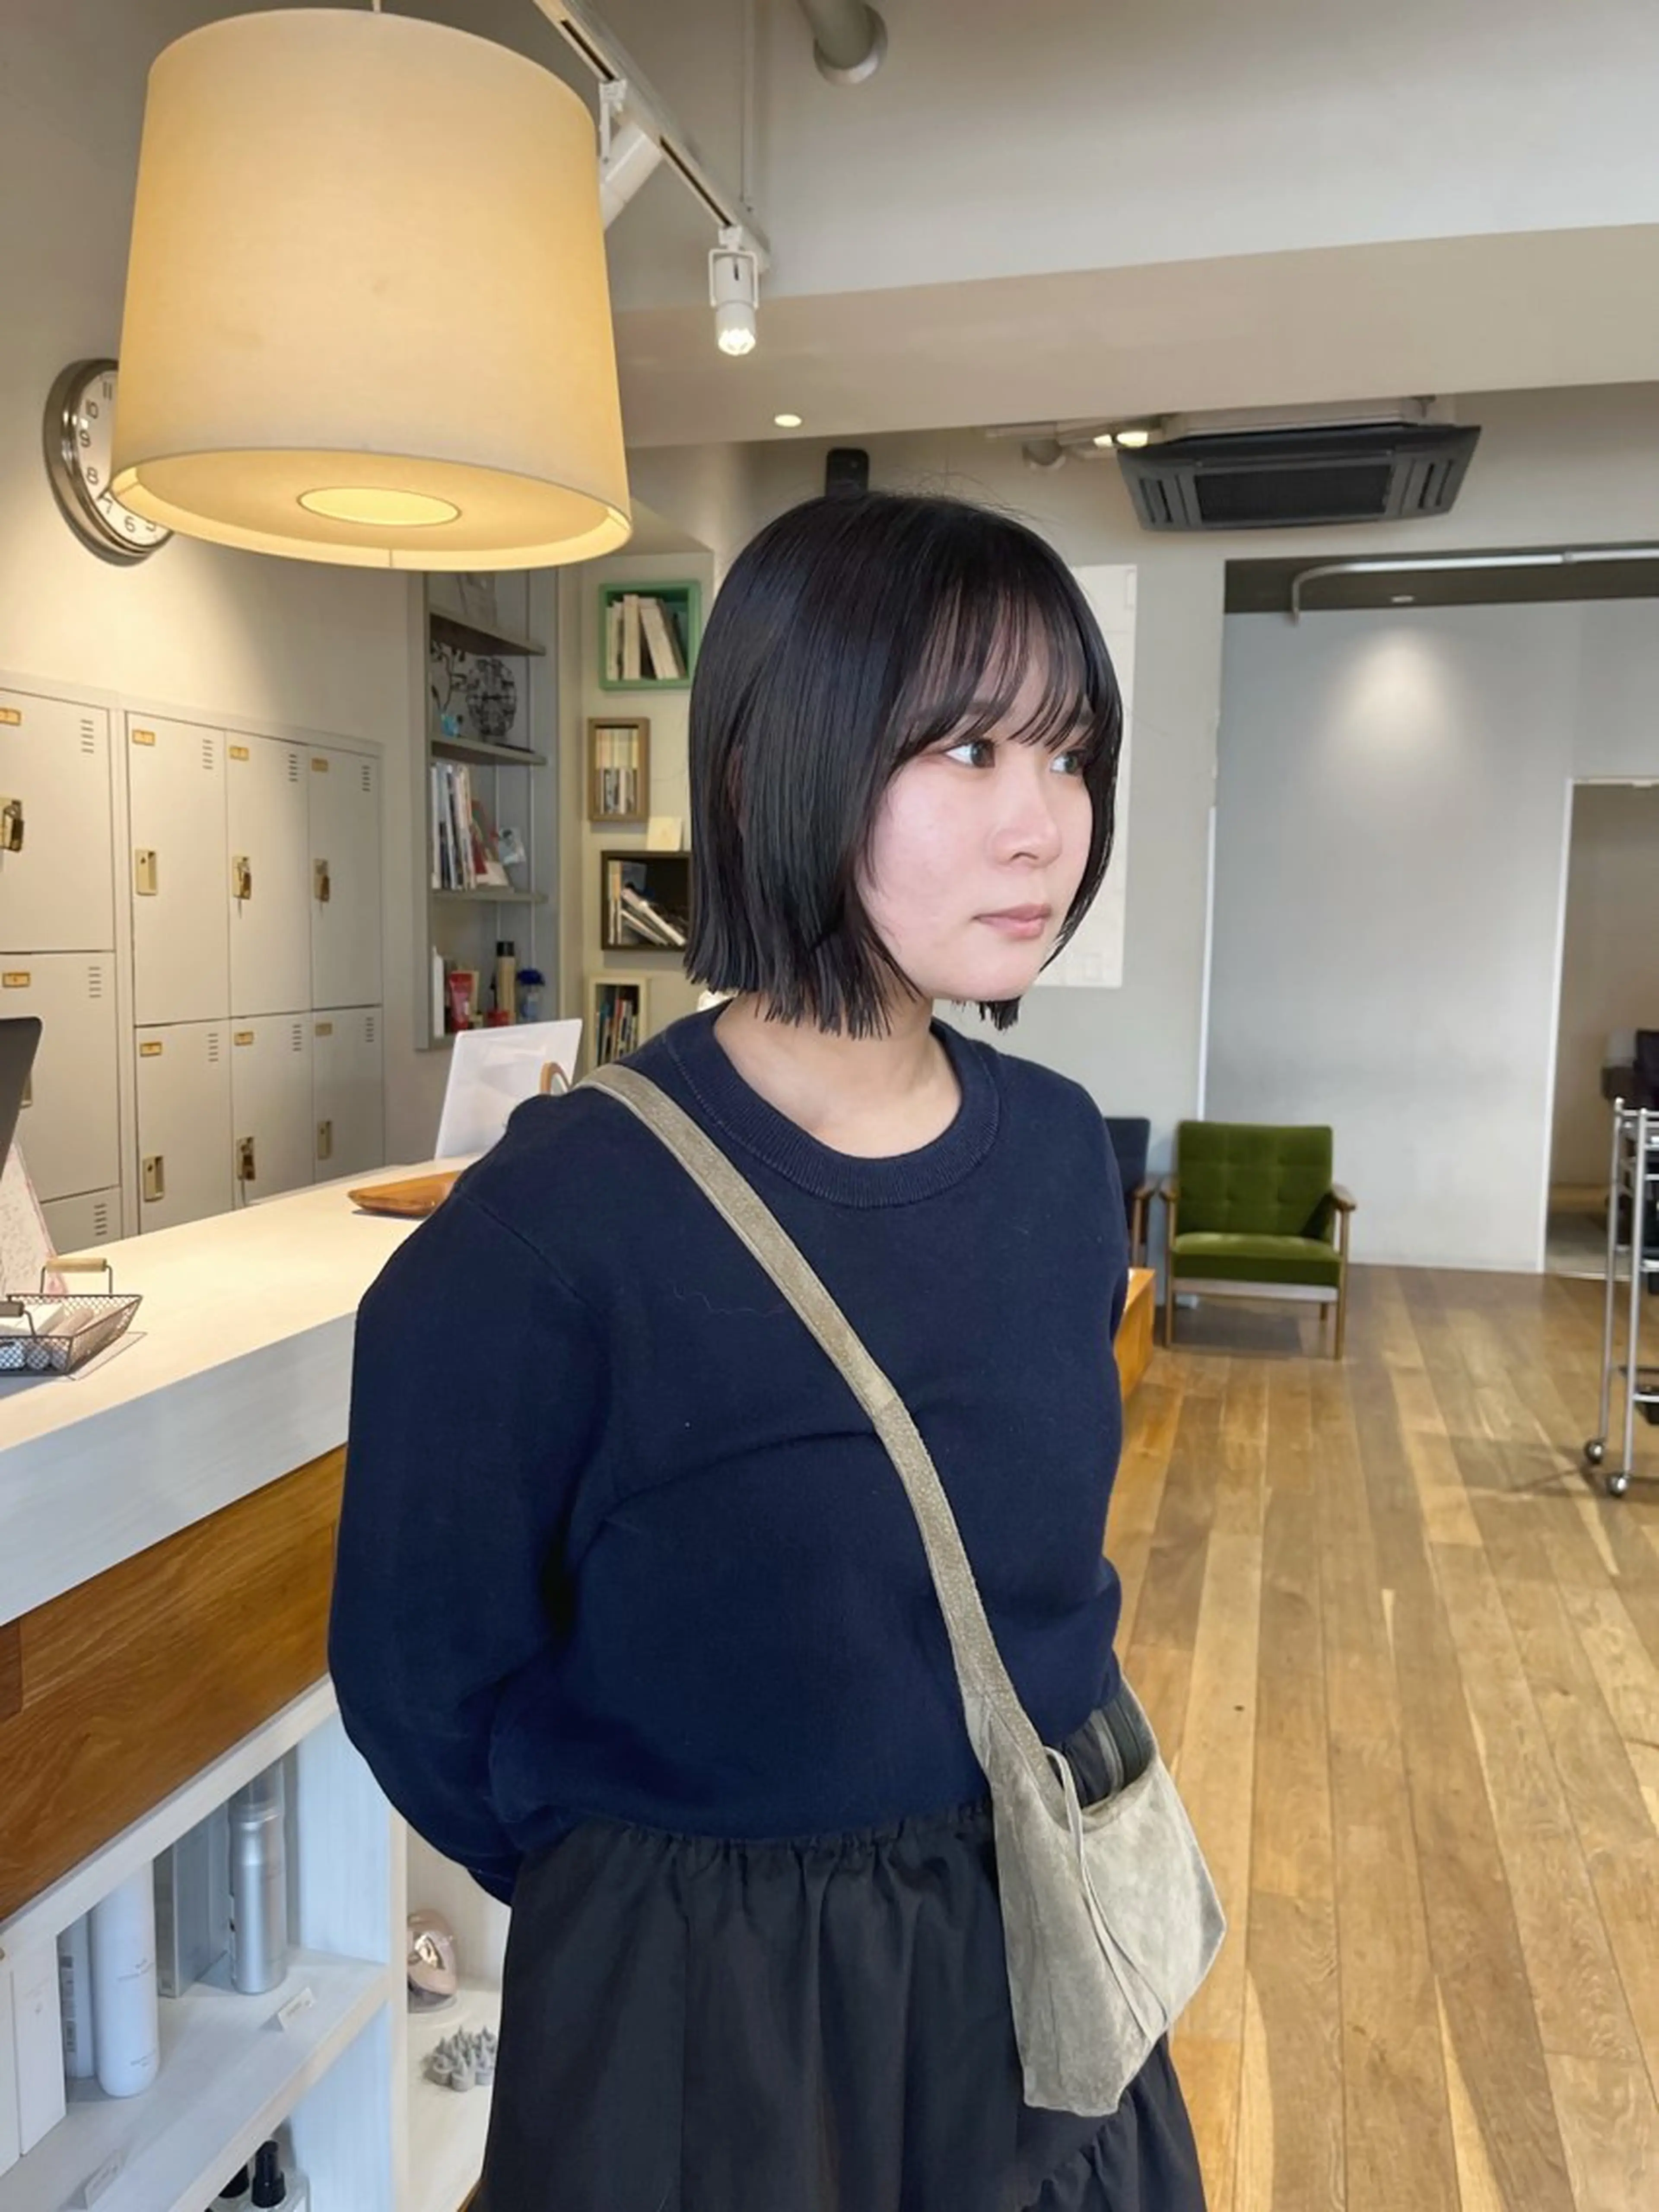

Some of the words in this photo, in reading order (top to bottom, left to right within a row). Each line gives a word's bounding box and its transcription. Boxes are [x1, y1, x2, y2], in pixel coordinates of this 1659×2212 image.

[102, 381, 112, 401] 11
[86, 398, 99, 419] 10
[79, 429, 91, 448] 9
[86, 467, 99, 486] 8
[101, 495, 113, 514] 7
[124, 515, 136, 533] 6
